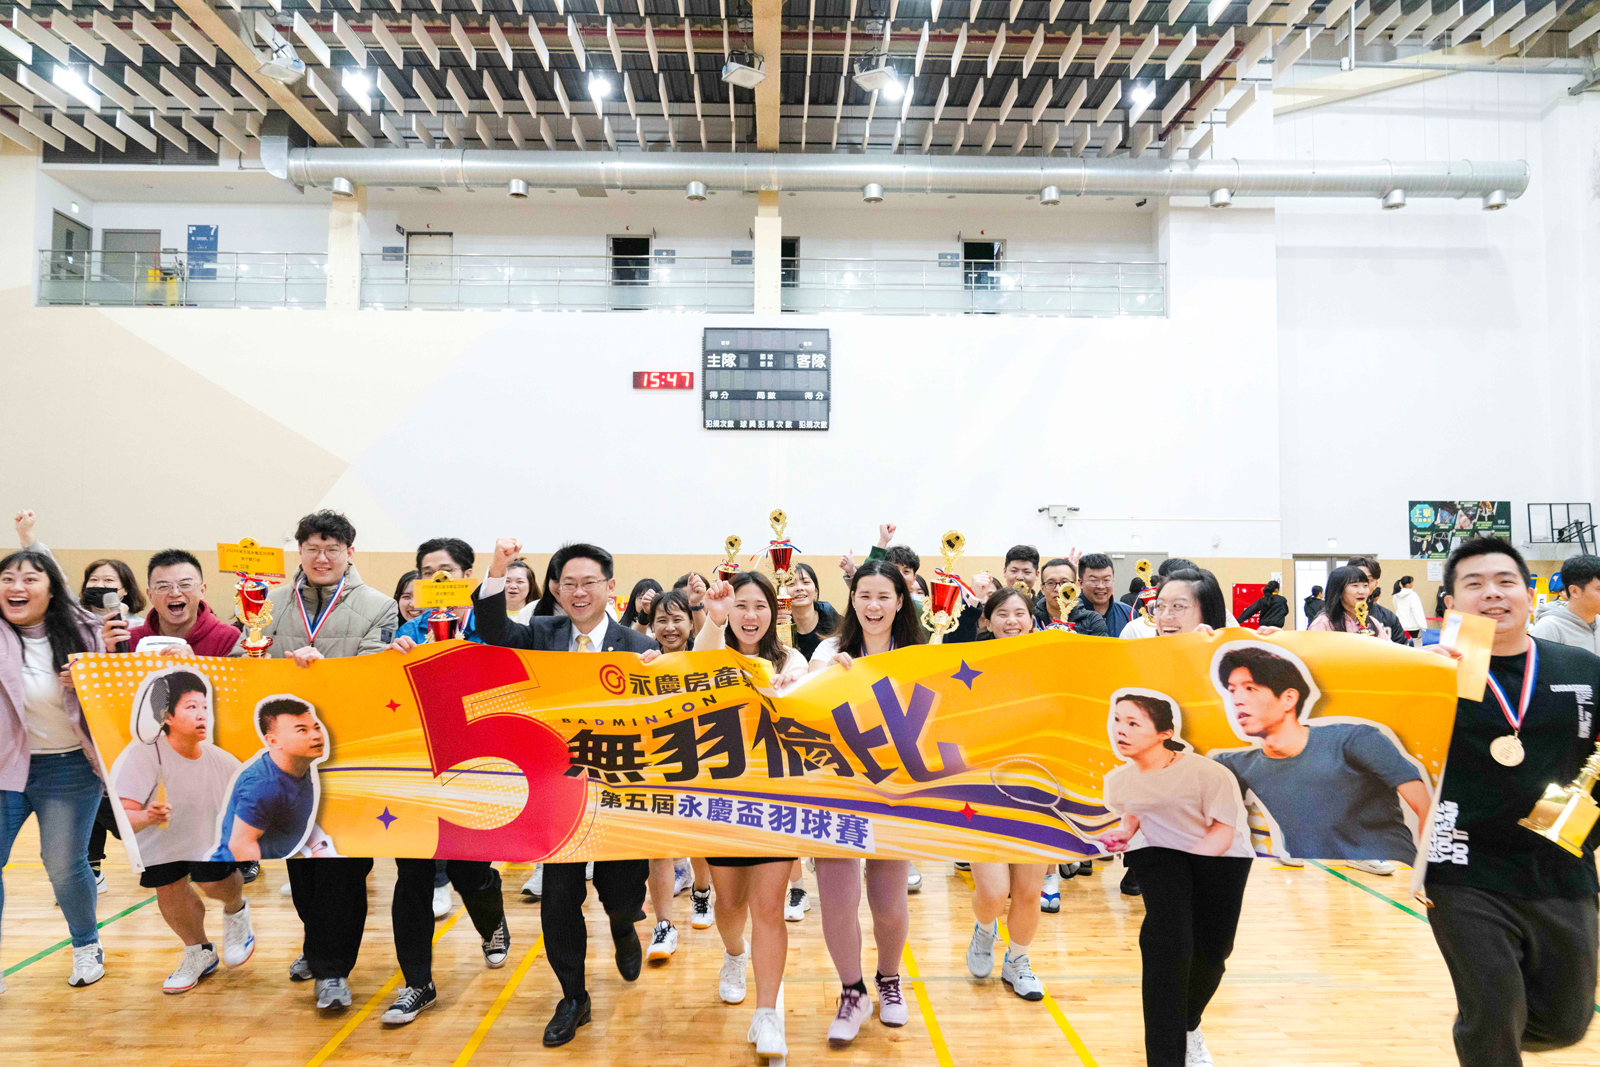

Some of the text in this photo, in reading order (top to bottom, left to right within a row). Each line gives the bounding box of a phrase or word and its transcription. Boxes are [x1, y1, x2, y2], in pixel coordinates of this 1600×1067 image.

[706, 353, 737, 368] 主隊
[796, 353, 826, 369] 客隊
[643, 372, 690, 388] 15:47
[709, 391, 729, 400] 得分
[756, 391, 776, 400] 局數
[804, 391, 824, 400] 得分
[629, 666, 765, 701] 永慶房產
[562, 694, 717, 727] BADMINTON
[563, 676, 967, 785] 無羽倫比
[403, 642, 589, 863] 5
[600, 789, 869, 850] 第五屆永慶盃羽球賽
[1451, 828, 1469, 865] DO IT
